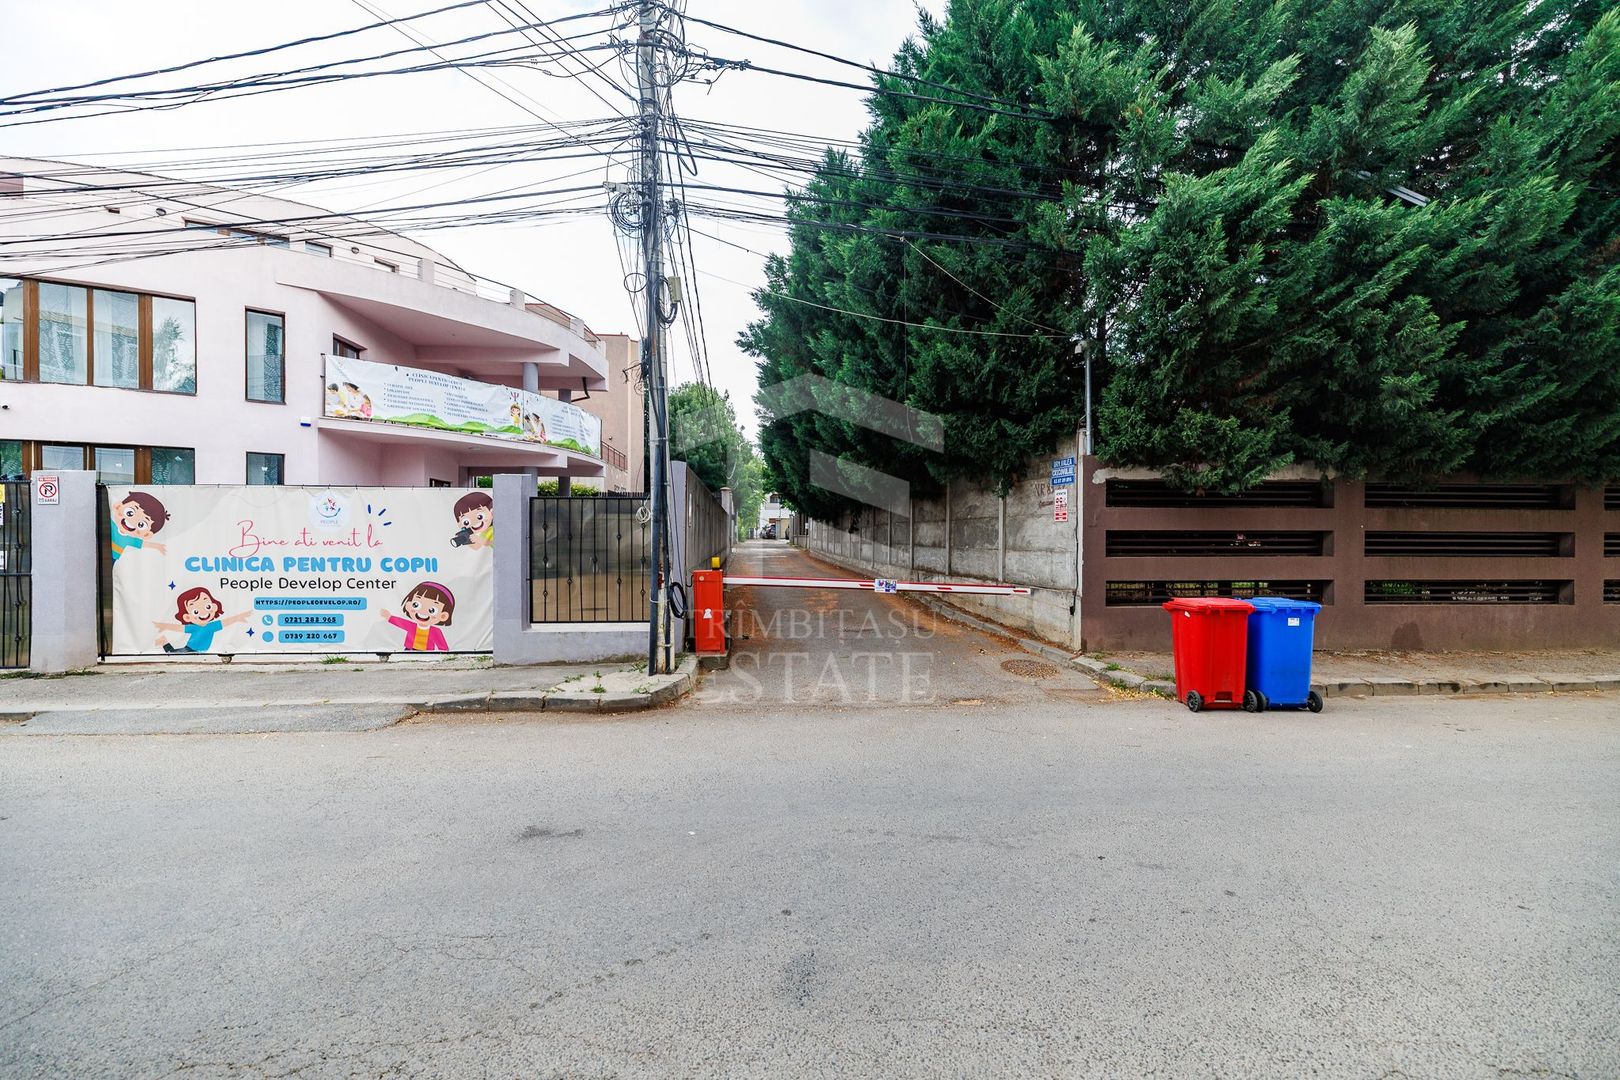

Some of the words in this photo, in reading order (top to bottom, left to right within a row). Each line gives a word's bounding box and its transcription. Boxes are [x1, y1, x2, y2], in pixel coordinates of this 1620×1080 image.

[228, 519, 289, 558] Bine
[294, 527, 317, 547] ati
[322, 527, 361, 547] venit
[367, 523, 383, 548] la
[185, 556, 275, 573] CLINICA
[283, 556, 372, 573] PENTRU
[380, 557, 438, 574] COPII
[220, 577, 273, 592] People
[278, 577, 342, 592] Develop
[346, 577, 397, 590] Center
